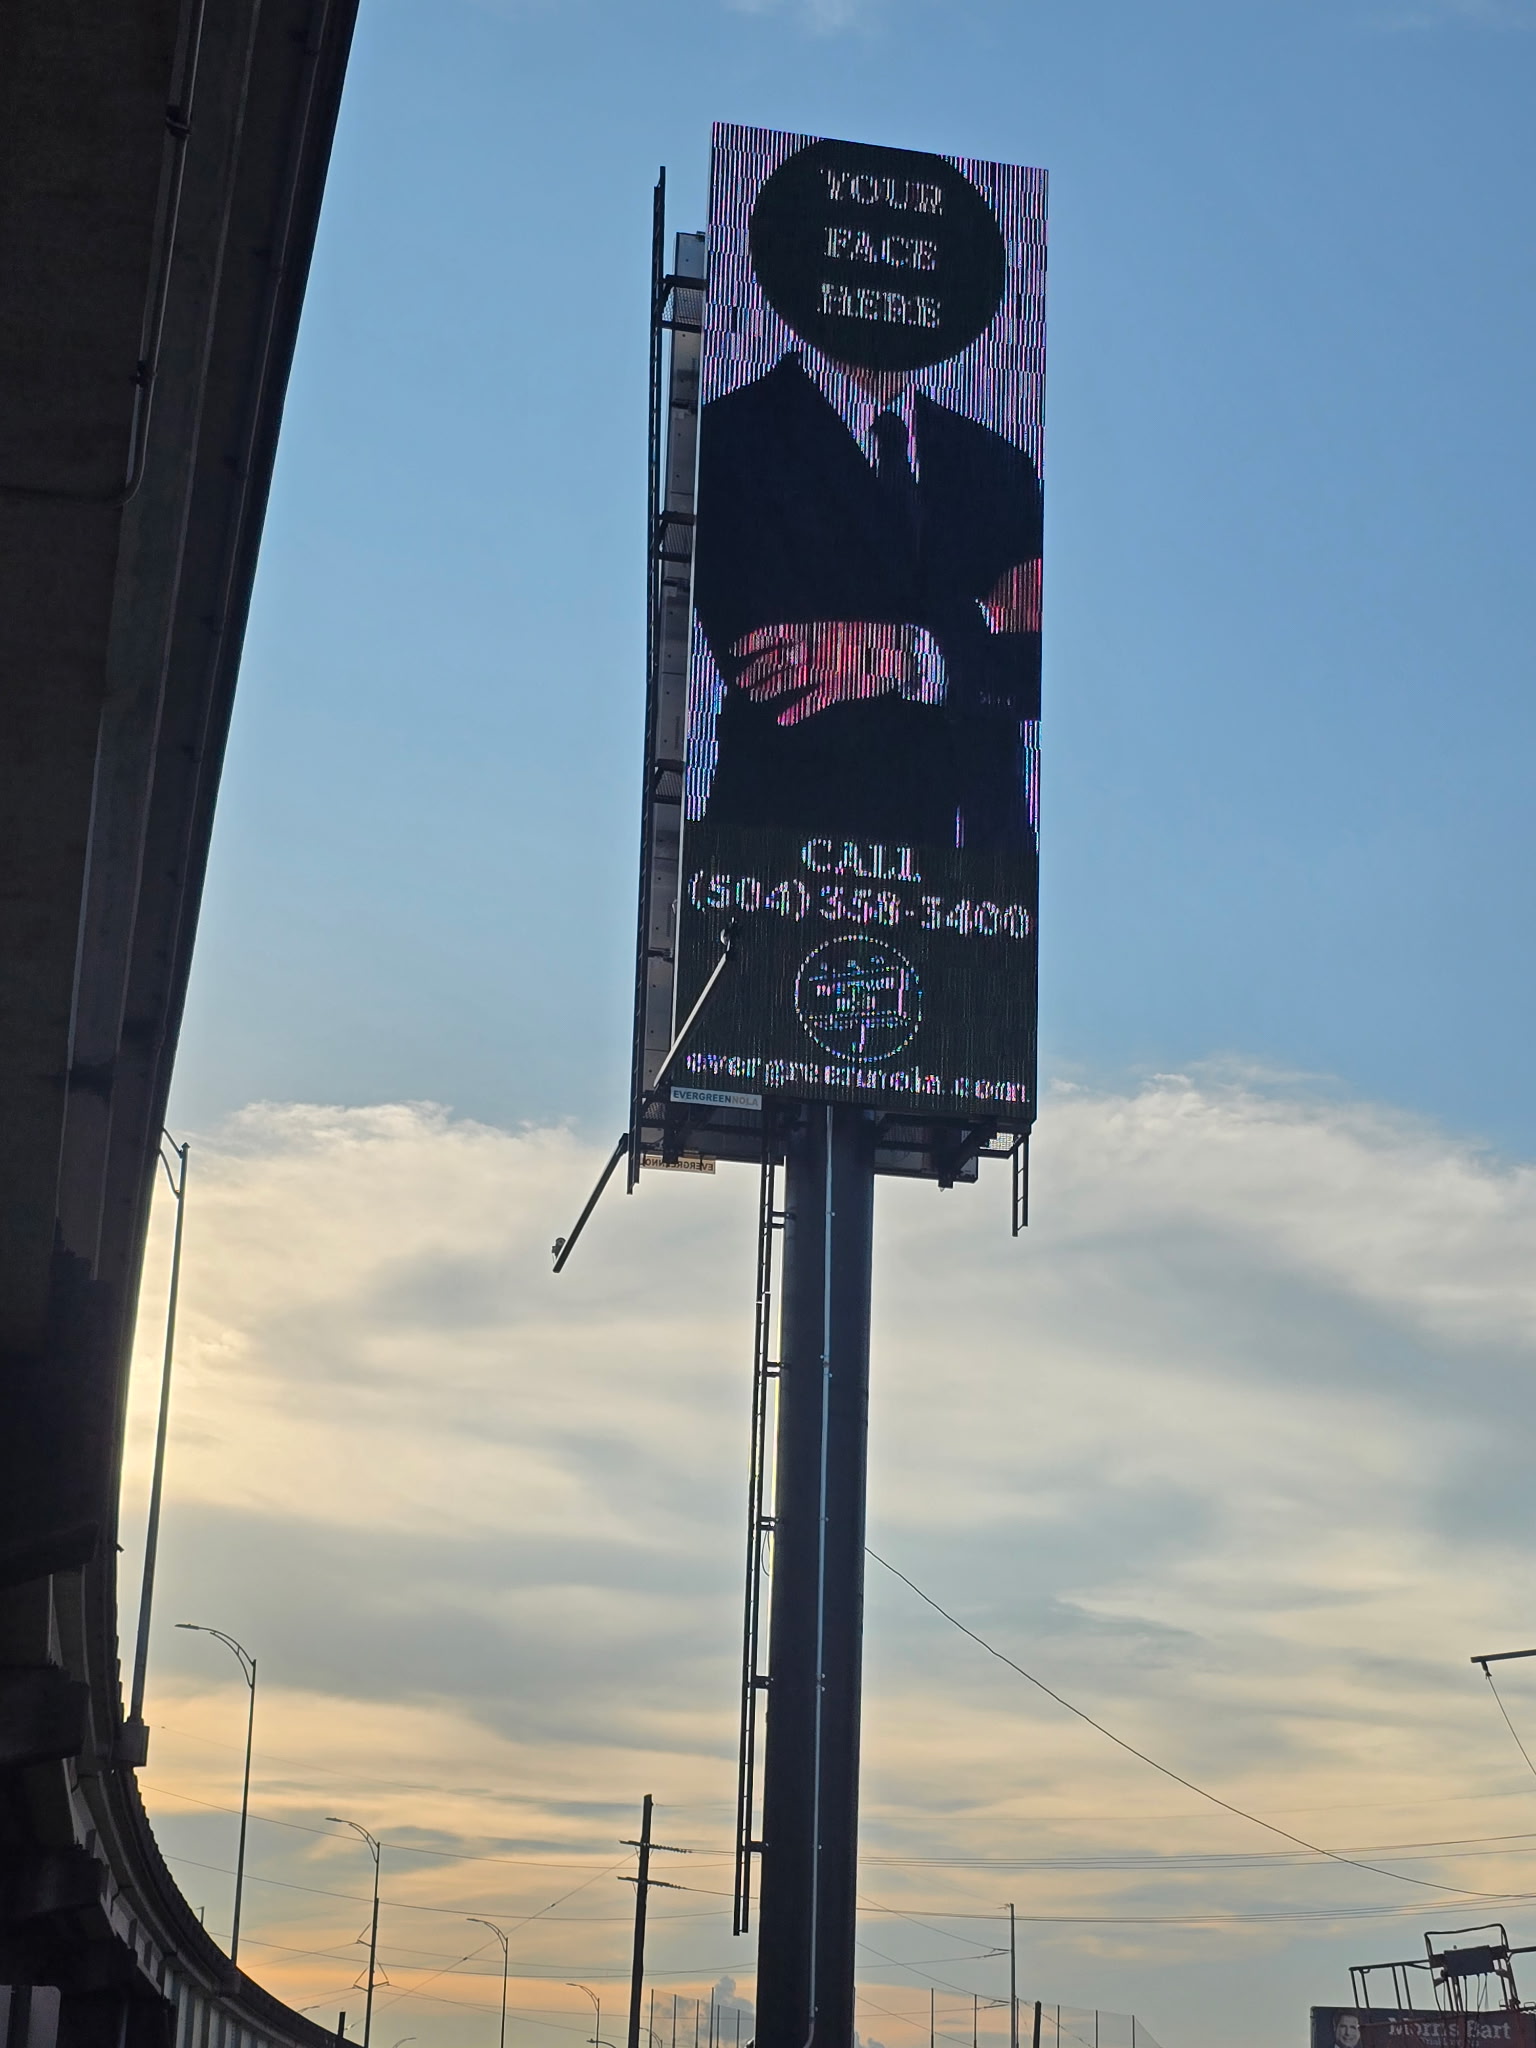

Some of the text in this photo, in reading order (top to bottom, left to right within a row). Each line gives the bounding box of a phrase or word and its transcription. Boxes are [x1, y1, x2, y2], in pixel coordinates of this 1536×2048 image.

[818, 168, 943, 216] YOUR
[823, 226, 938, 271] FACE
[816, 281, 941, 329] HERE
[802, 838, 922, 882] CALL
[687, 869, 810, 923] (504)
